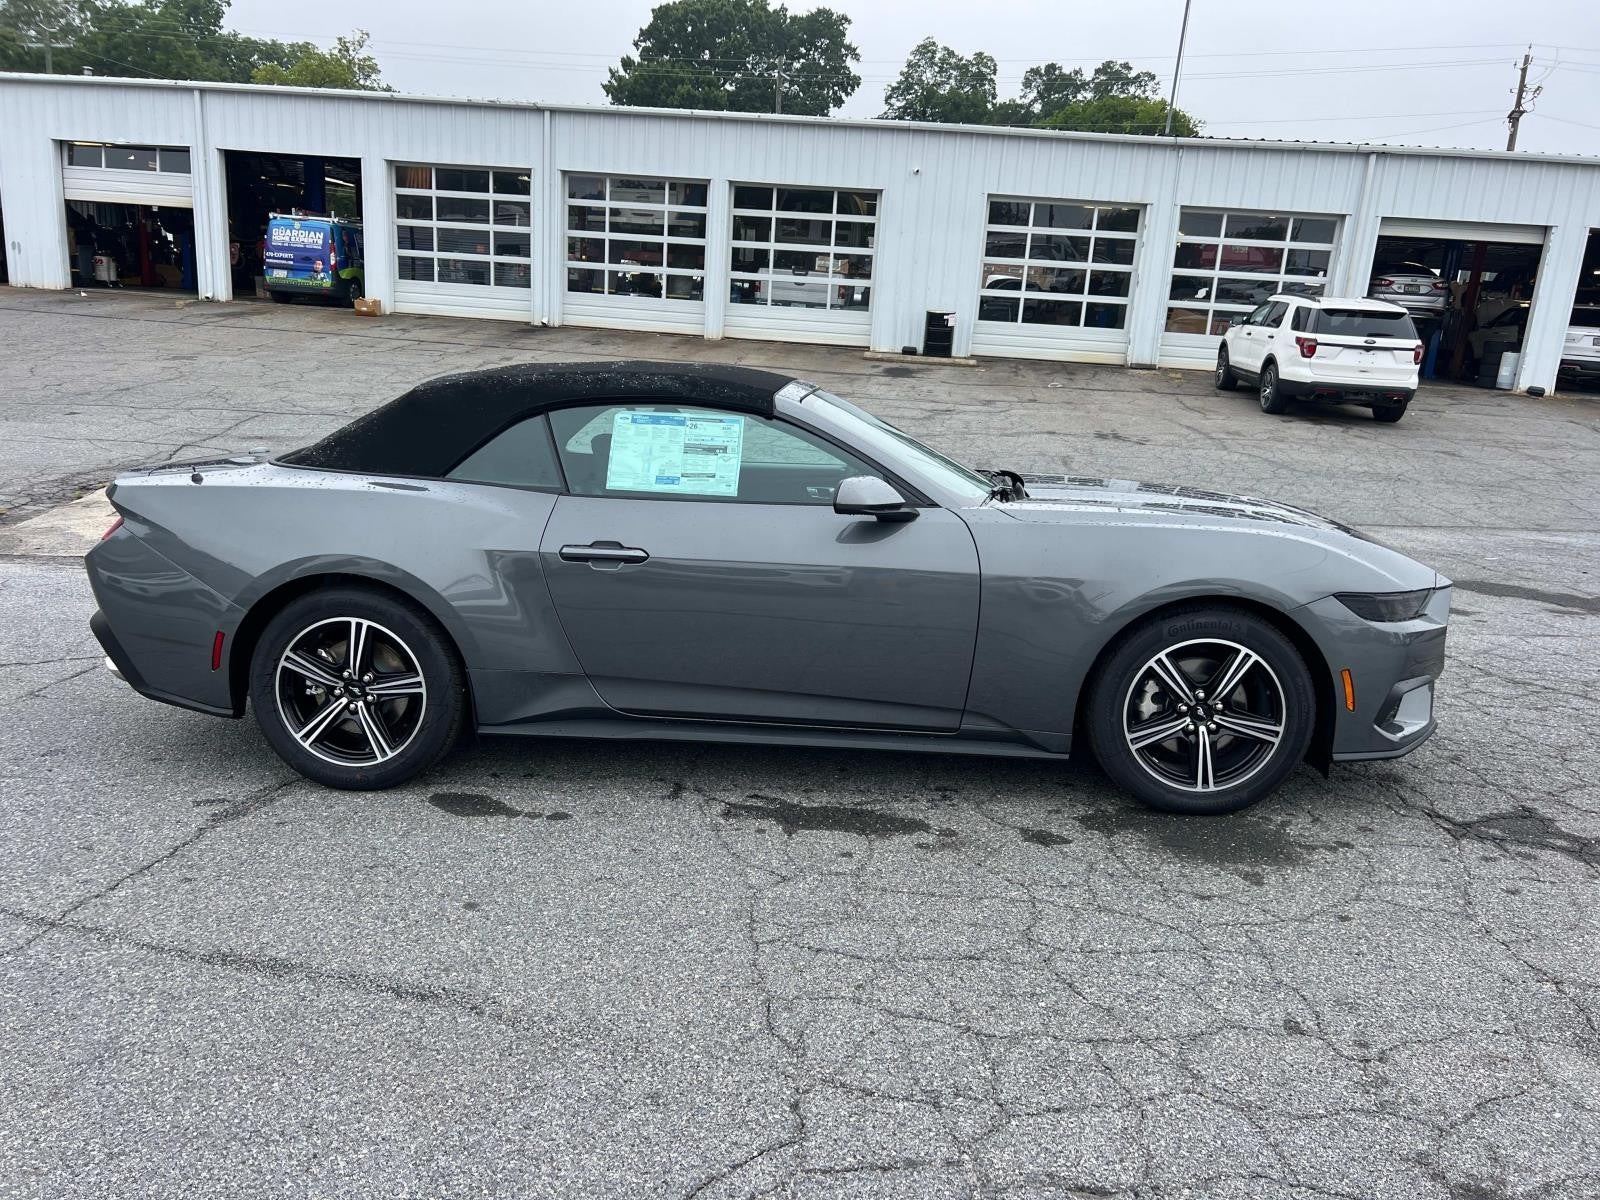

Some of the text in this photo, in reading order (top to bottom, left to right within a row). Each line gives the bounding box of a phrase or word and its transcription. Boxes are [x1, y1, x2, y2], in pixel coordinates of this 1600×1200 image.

[272, 226, 324, 239] GUARDIAN
[291, 236, 323, 245] EXPERTS
[1167, 619, 1233, 637] Continental
